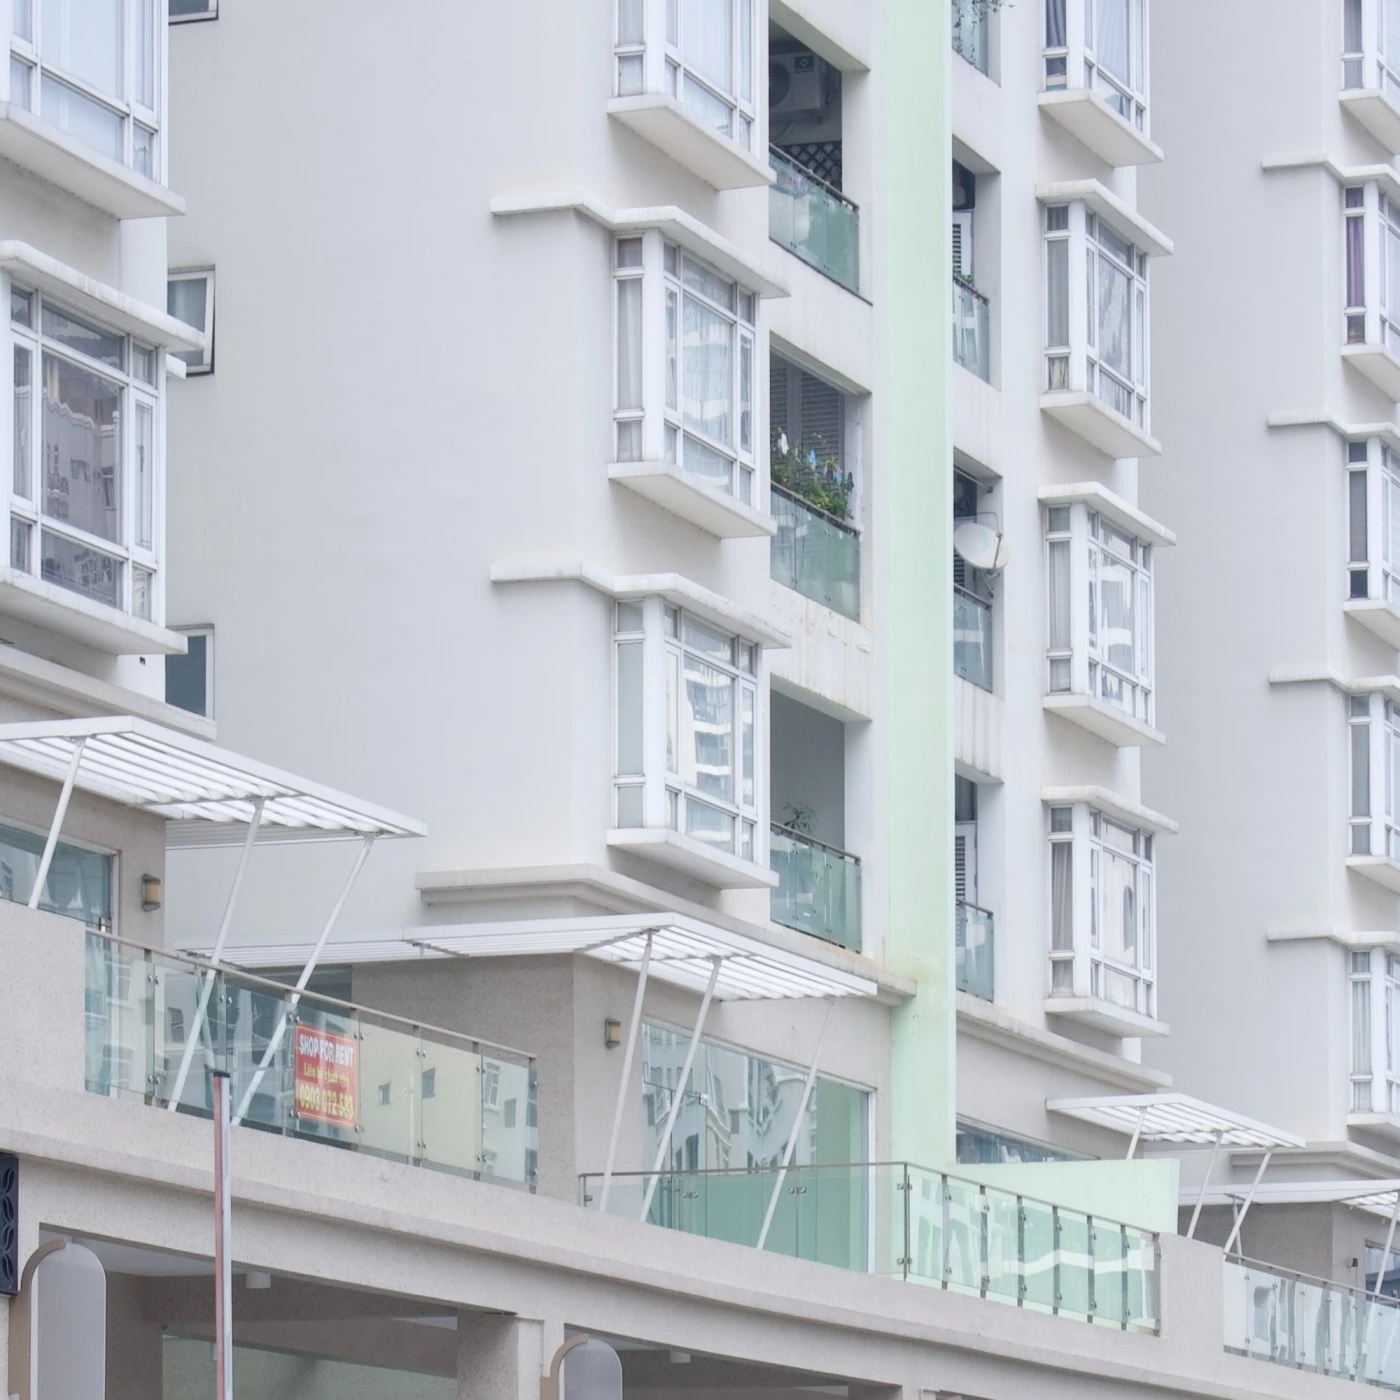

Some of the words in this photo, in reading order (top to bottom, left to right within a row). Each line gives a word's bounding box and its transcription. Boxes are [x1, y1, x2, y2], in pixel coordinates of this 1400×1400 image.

[299, 1033, 318, 1058] SHOP
[320, 1039, 334, 1062] FOR
[335, 1043, 354, 1068] RENT
